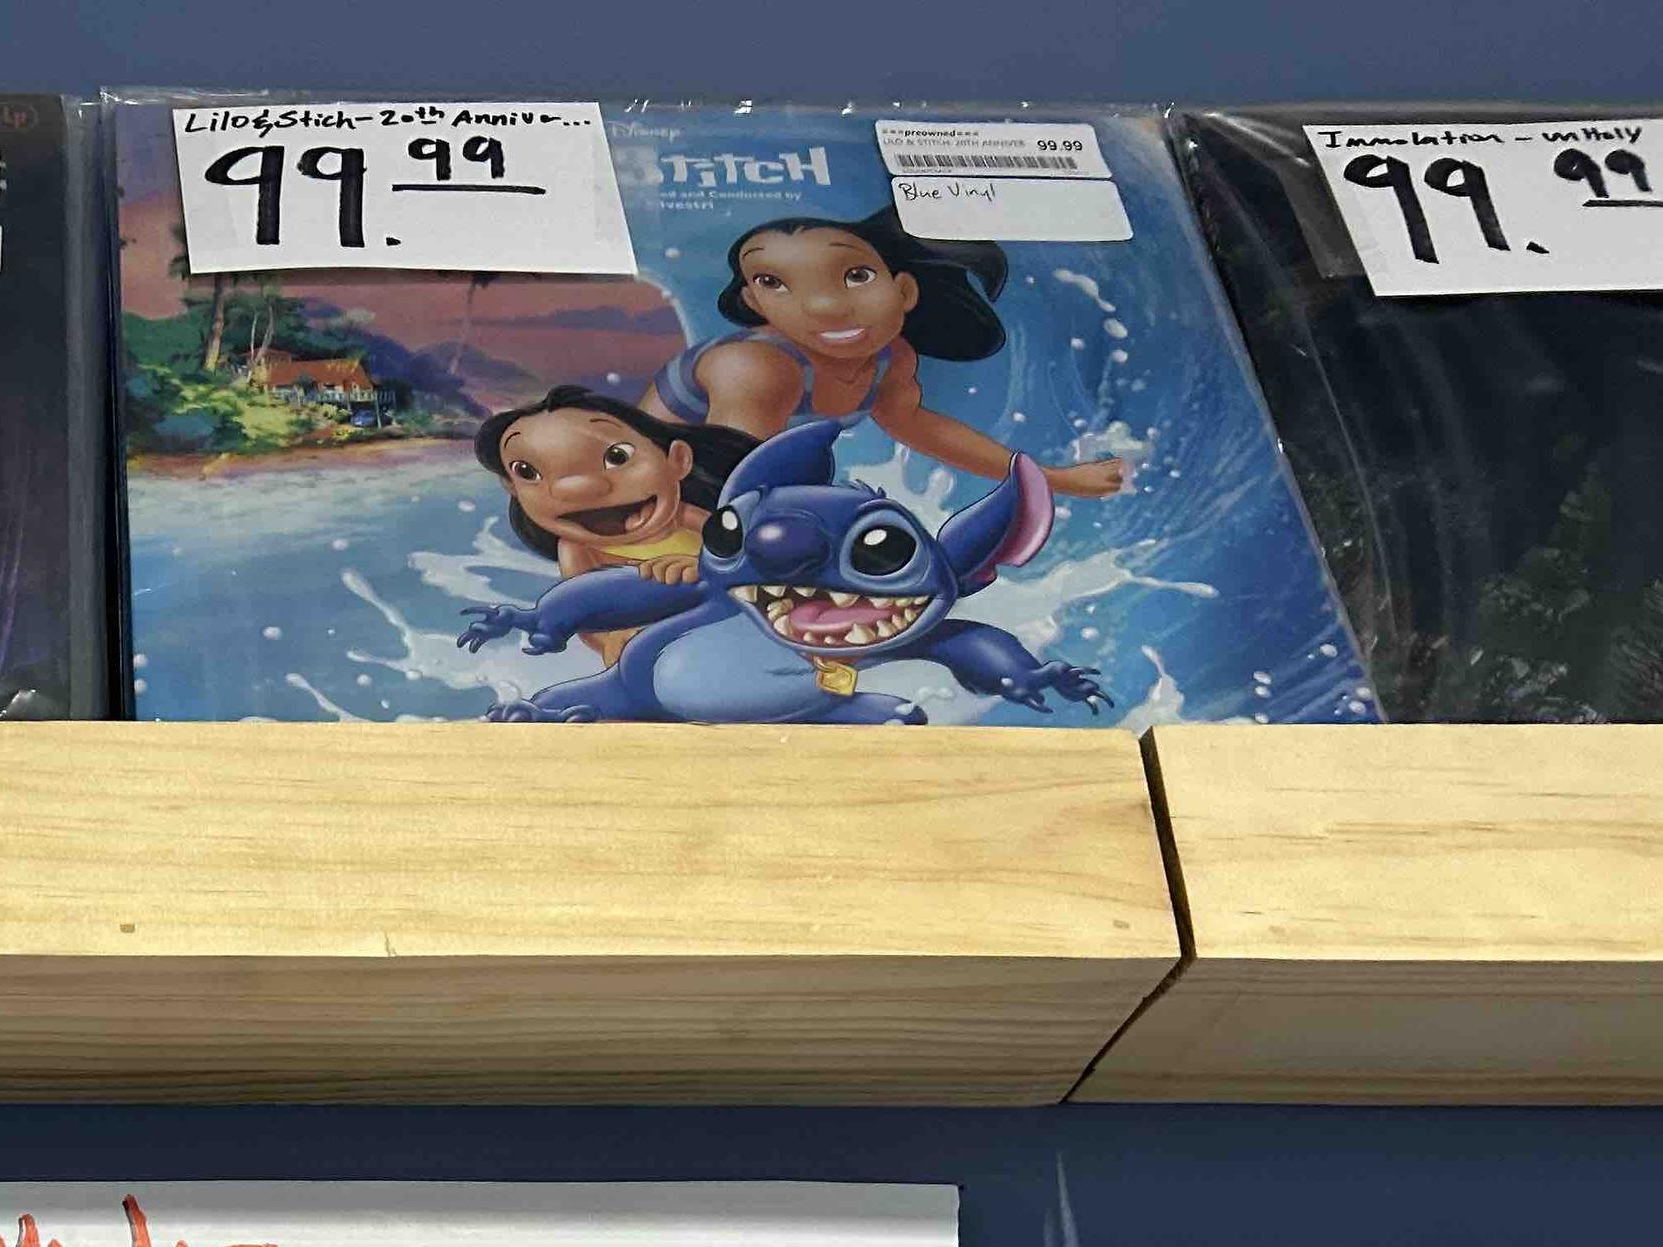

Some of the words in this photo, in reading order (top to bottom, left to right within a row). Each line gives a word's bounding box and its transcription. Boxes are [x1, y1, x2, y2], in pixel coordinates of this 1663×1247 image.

[1036, 140, 1084, 152] 99.99
[898, 183, 943, 201] Blue
[946, 183, 996, 202] Vinyl
